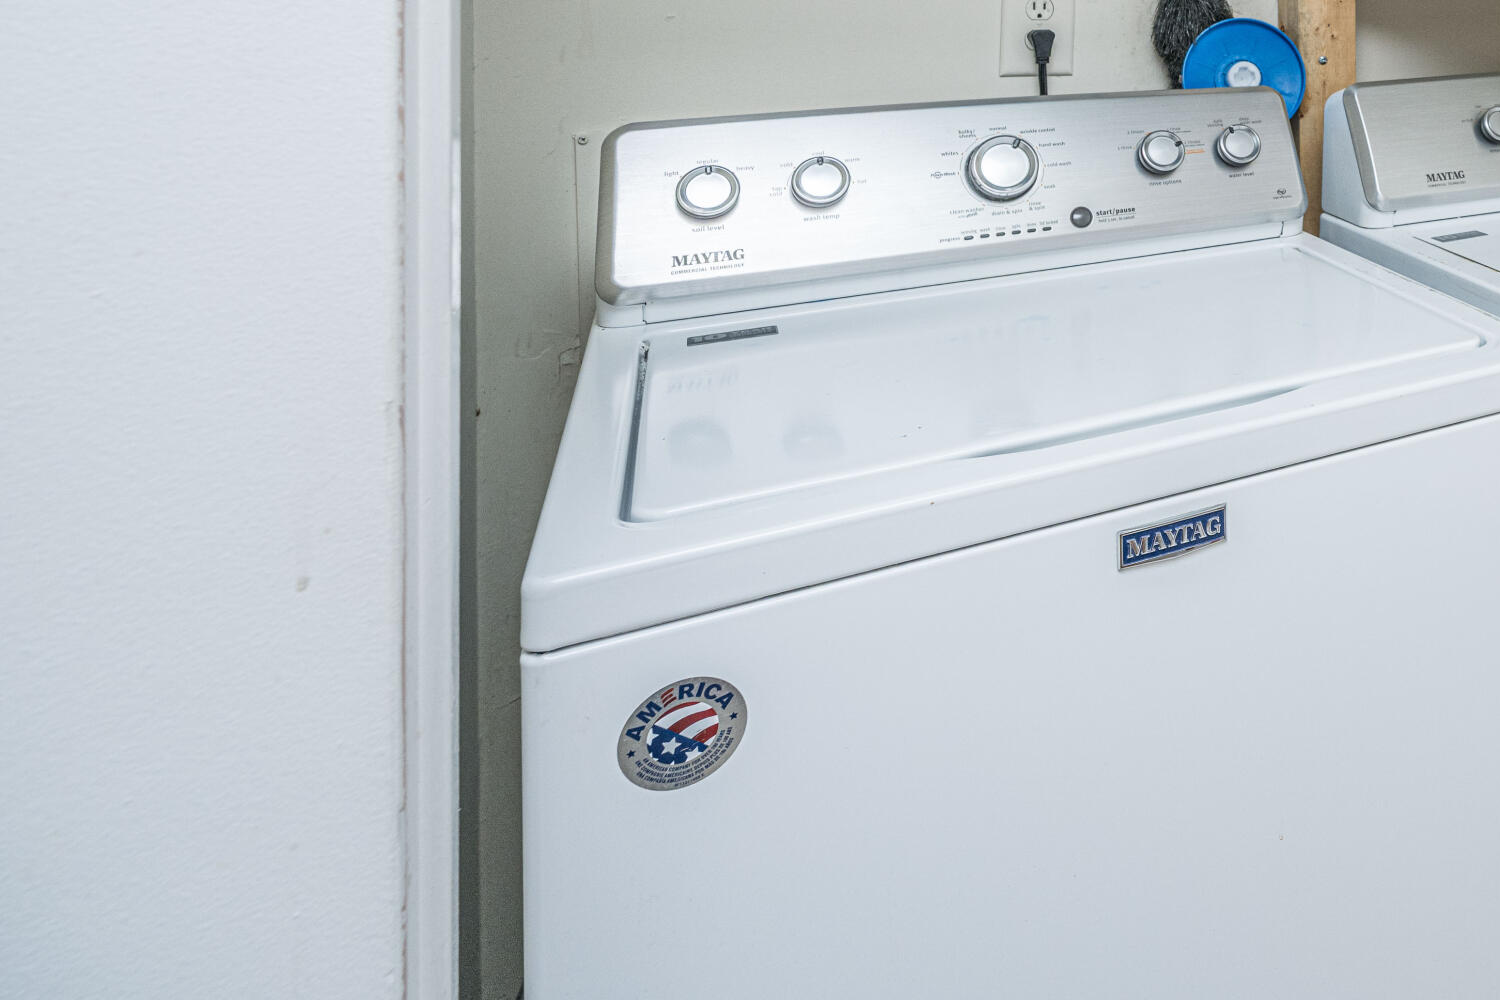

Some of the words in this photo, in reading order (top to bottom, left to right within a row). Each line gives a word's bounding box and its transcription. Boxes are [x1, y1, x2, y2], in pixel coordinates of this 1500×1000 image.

[1426, 170, 1465, 182] MAYTAG
[1095, 207, 1136, 216] start/pause
[691, 225, 706, 233] soil
[671, 248, 745, 268] MAYTAG
[670, 267, 708, 276] COMMERCIAL
[1126, 515, 1222, 559] MAYTAG
[625, 682, 735, 742] AMERICA
[668, 763, 691, 772] COMPANY
